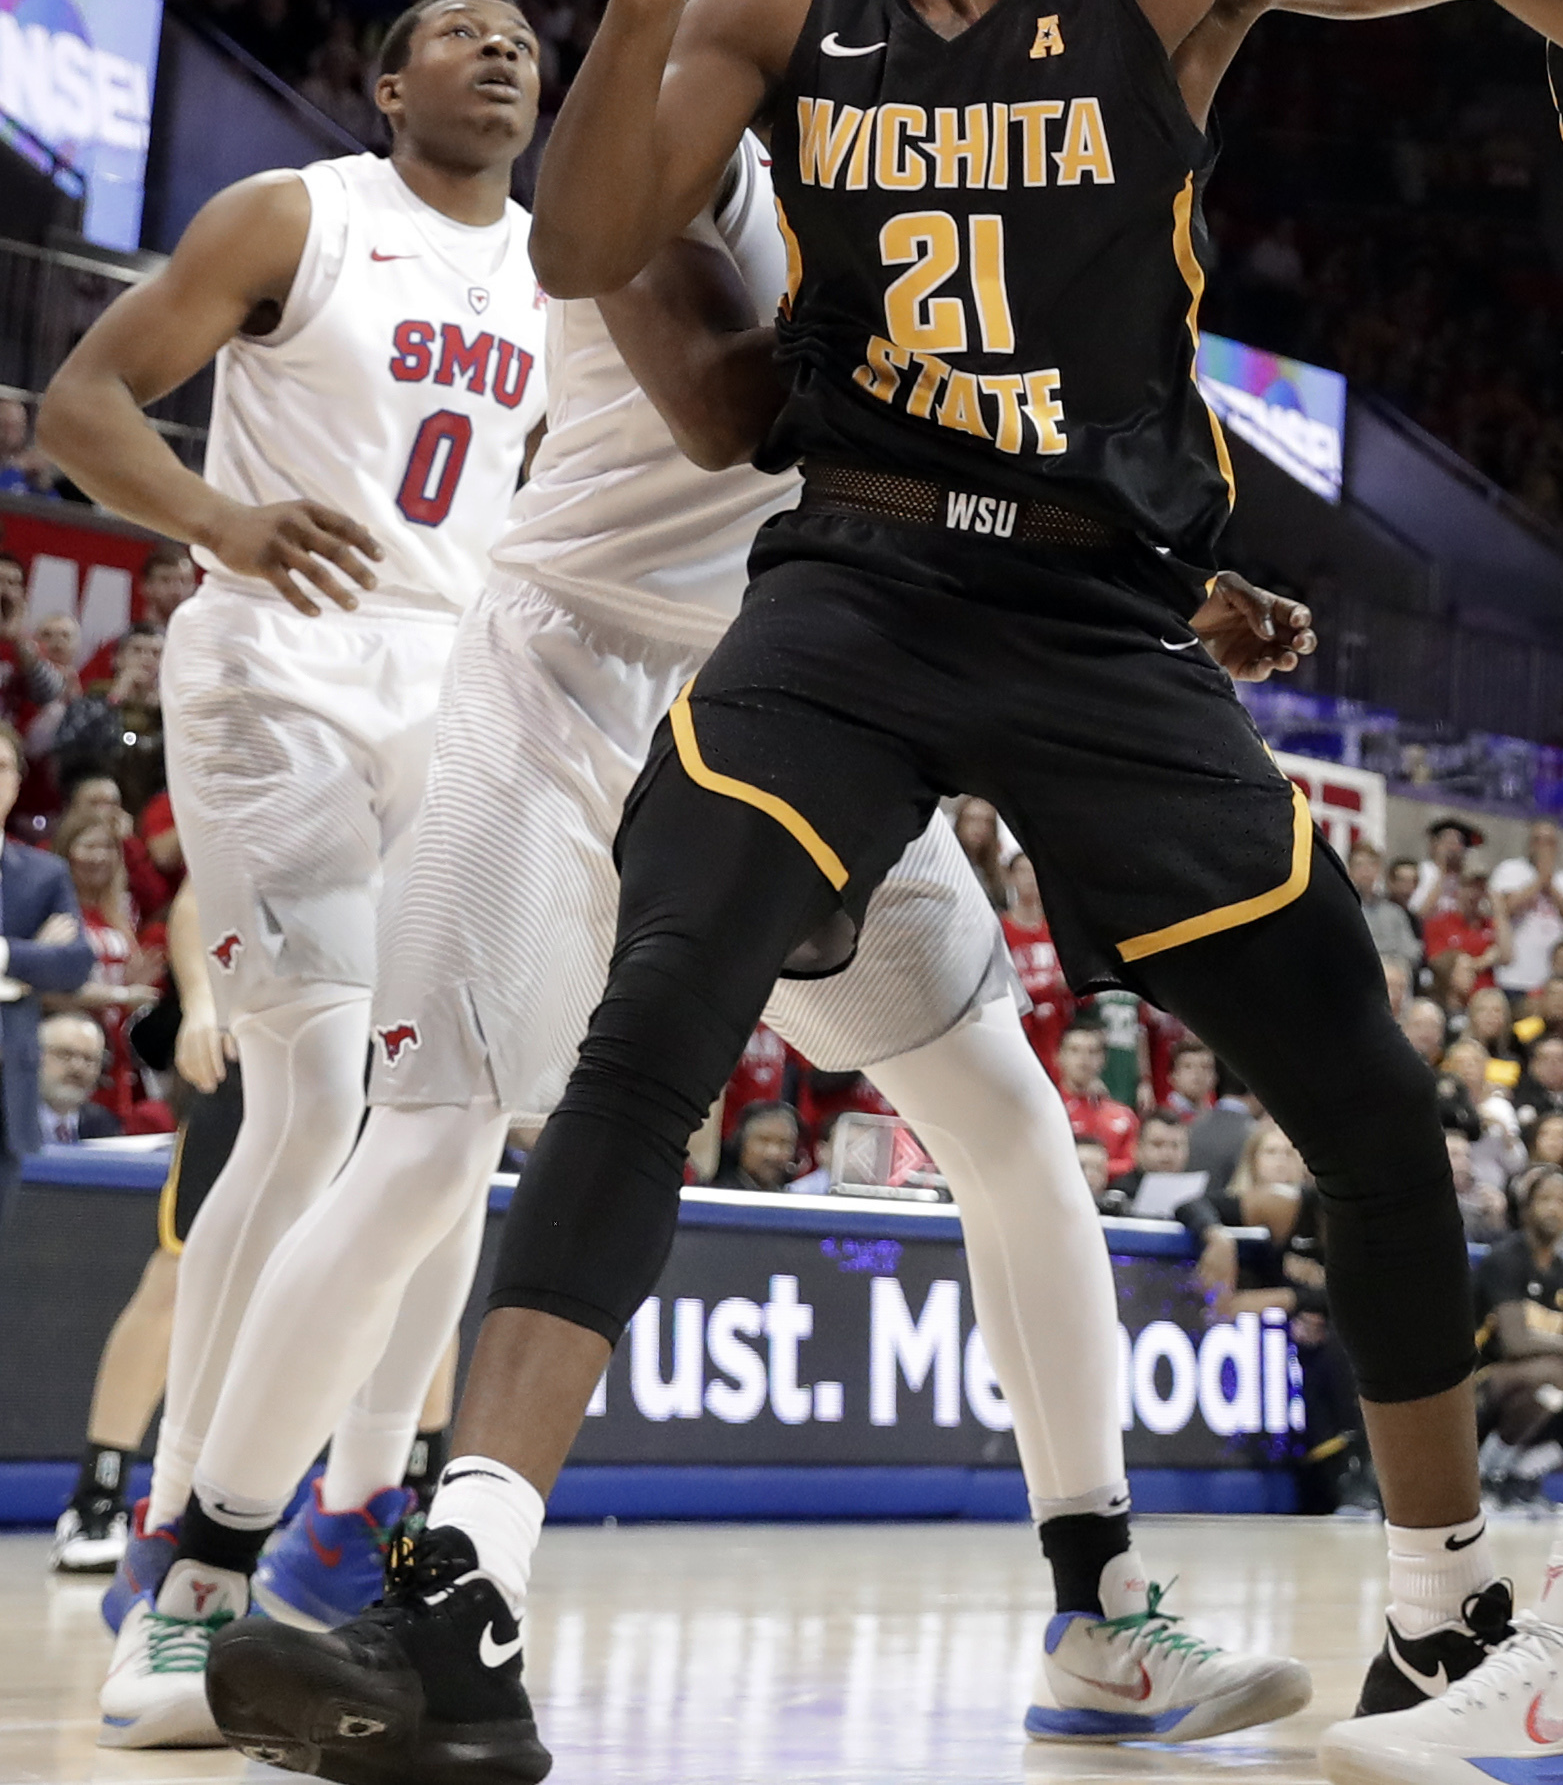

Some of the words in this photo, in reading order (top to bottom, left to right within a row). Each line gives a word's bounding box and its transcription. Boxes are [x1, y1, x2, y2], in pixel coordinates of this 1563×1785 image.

[797, 96, 1115, 191] WICHITA
[879, 210, 1015, 354] 21
[389, 319, 534, 410] SMU
[852, 335, 1068, 455] STATE
[395, 408, 472, 528] 0
[946, 491, 1017, 538] WSU
[585, 1274, 844, 1425] ust.
[869, 1277, 1306, 1436] Meodi
